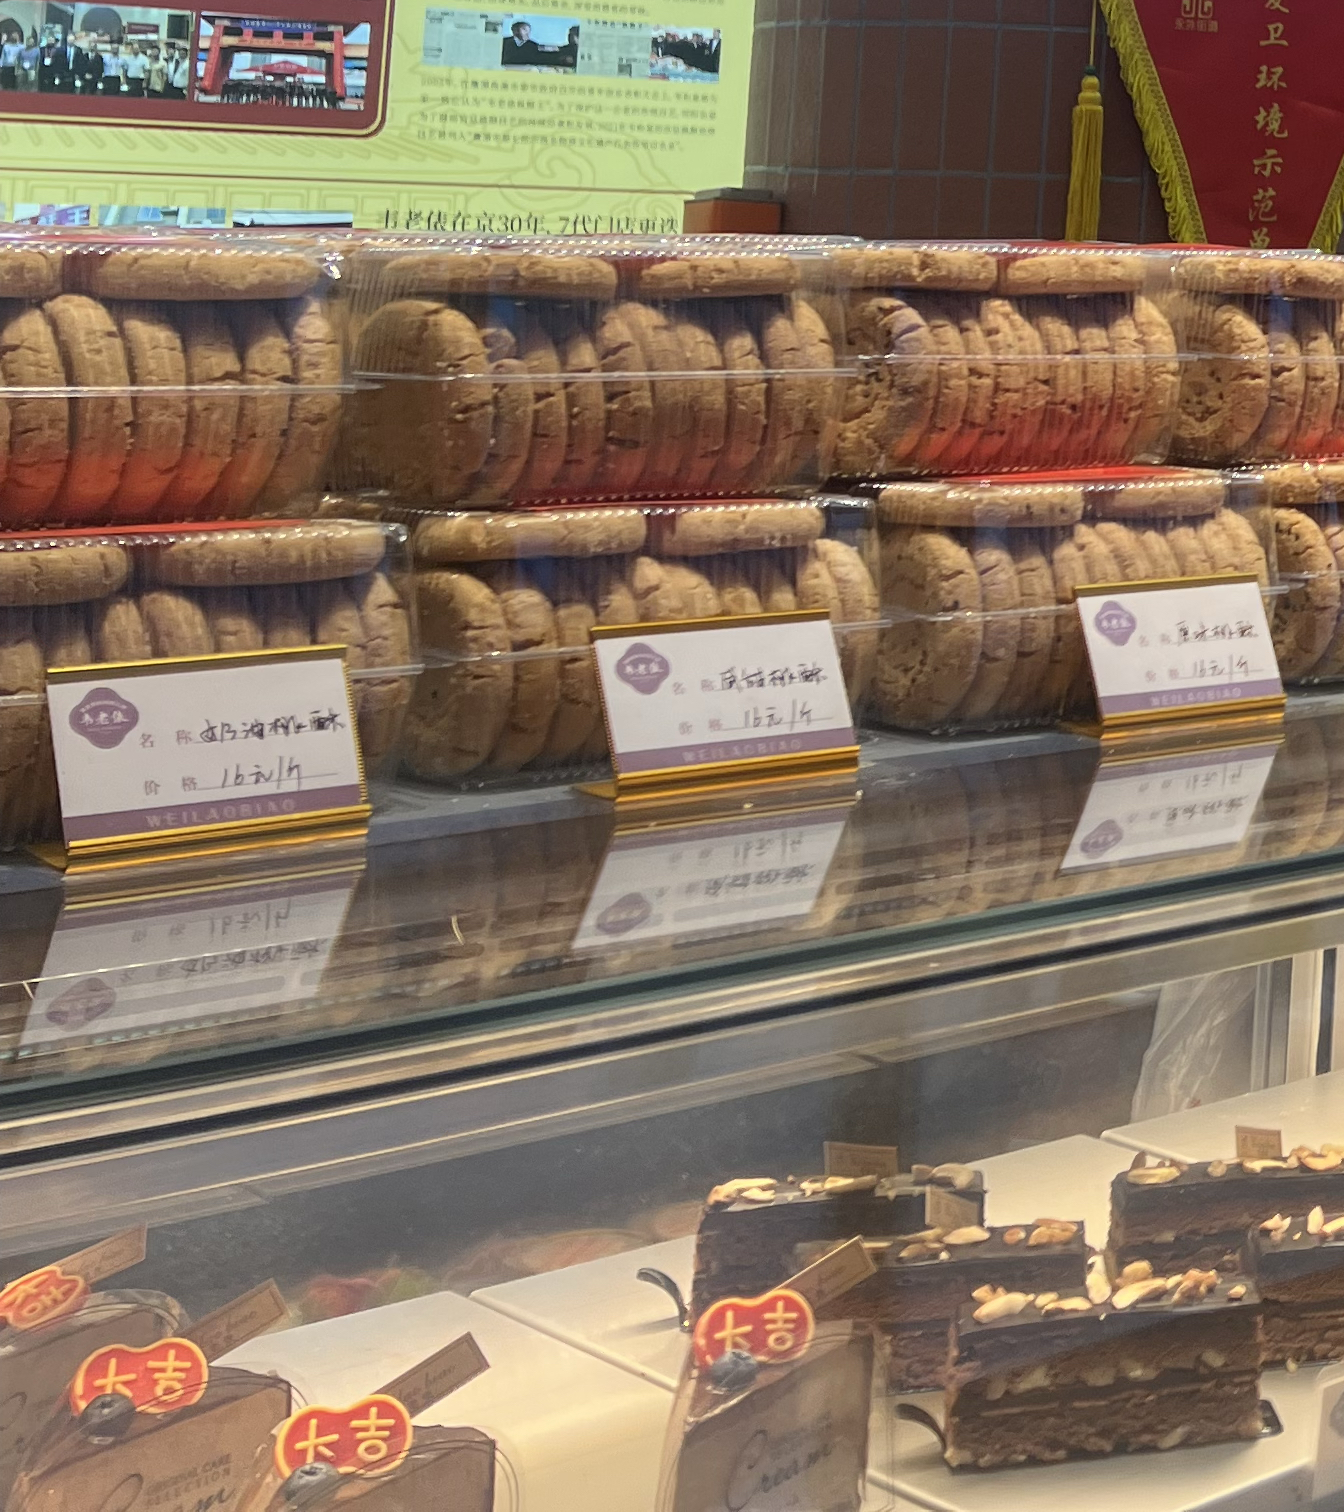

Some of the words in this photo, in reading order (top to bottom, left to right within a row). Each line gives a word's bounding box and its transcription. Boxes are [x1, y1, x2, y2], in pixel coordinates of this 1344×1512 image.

[145, 797, 297, 829] WEILAOBIAO
[714, 1299, 799, 1353] 大吉
[92, 1349, 192, 1402] 大吉
[294, 1406, 396, 1462] 大吉
